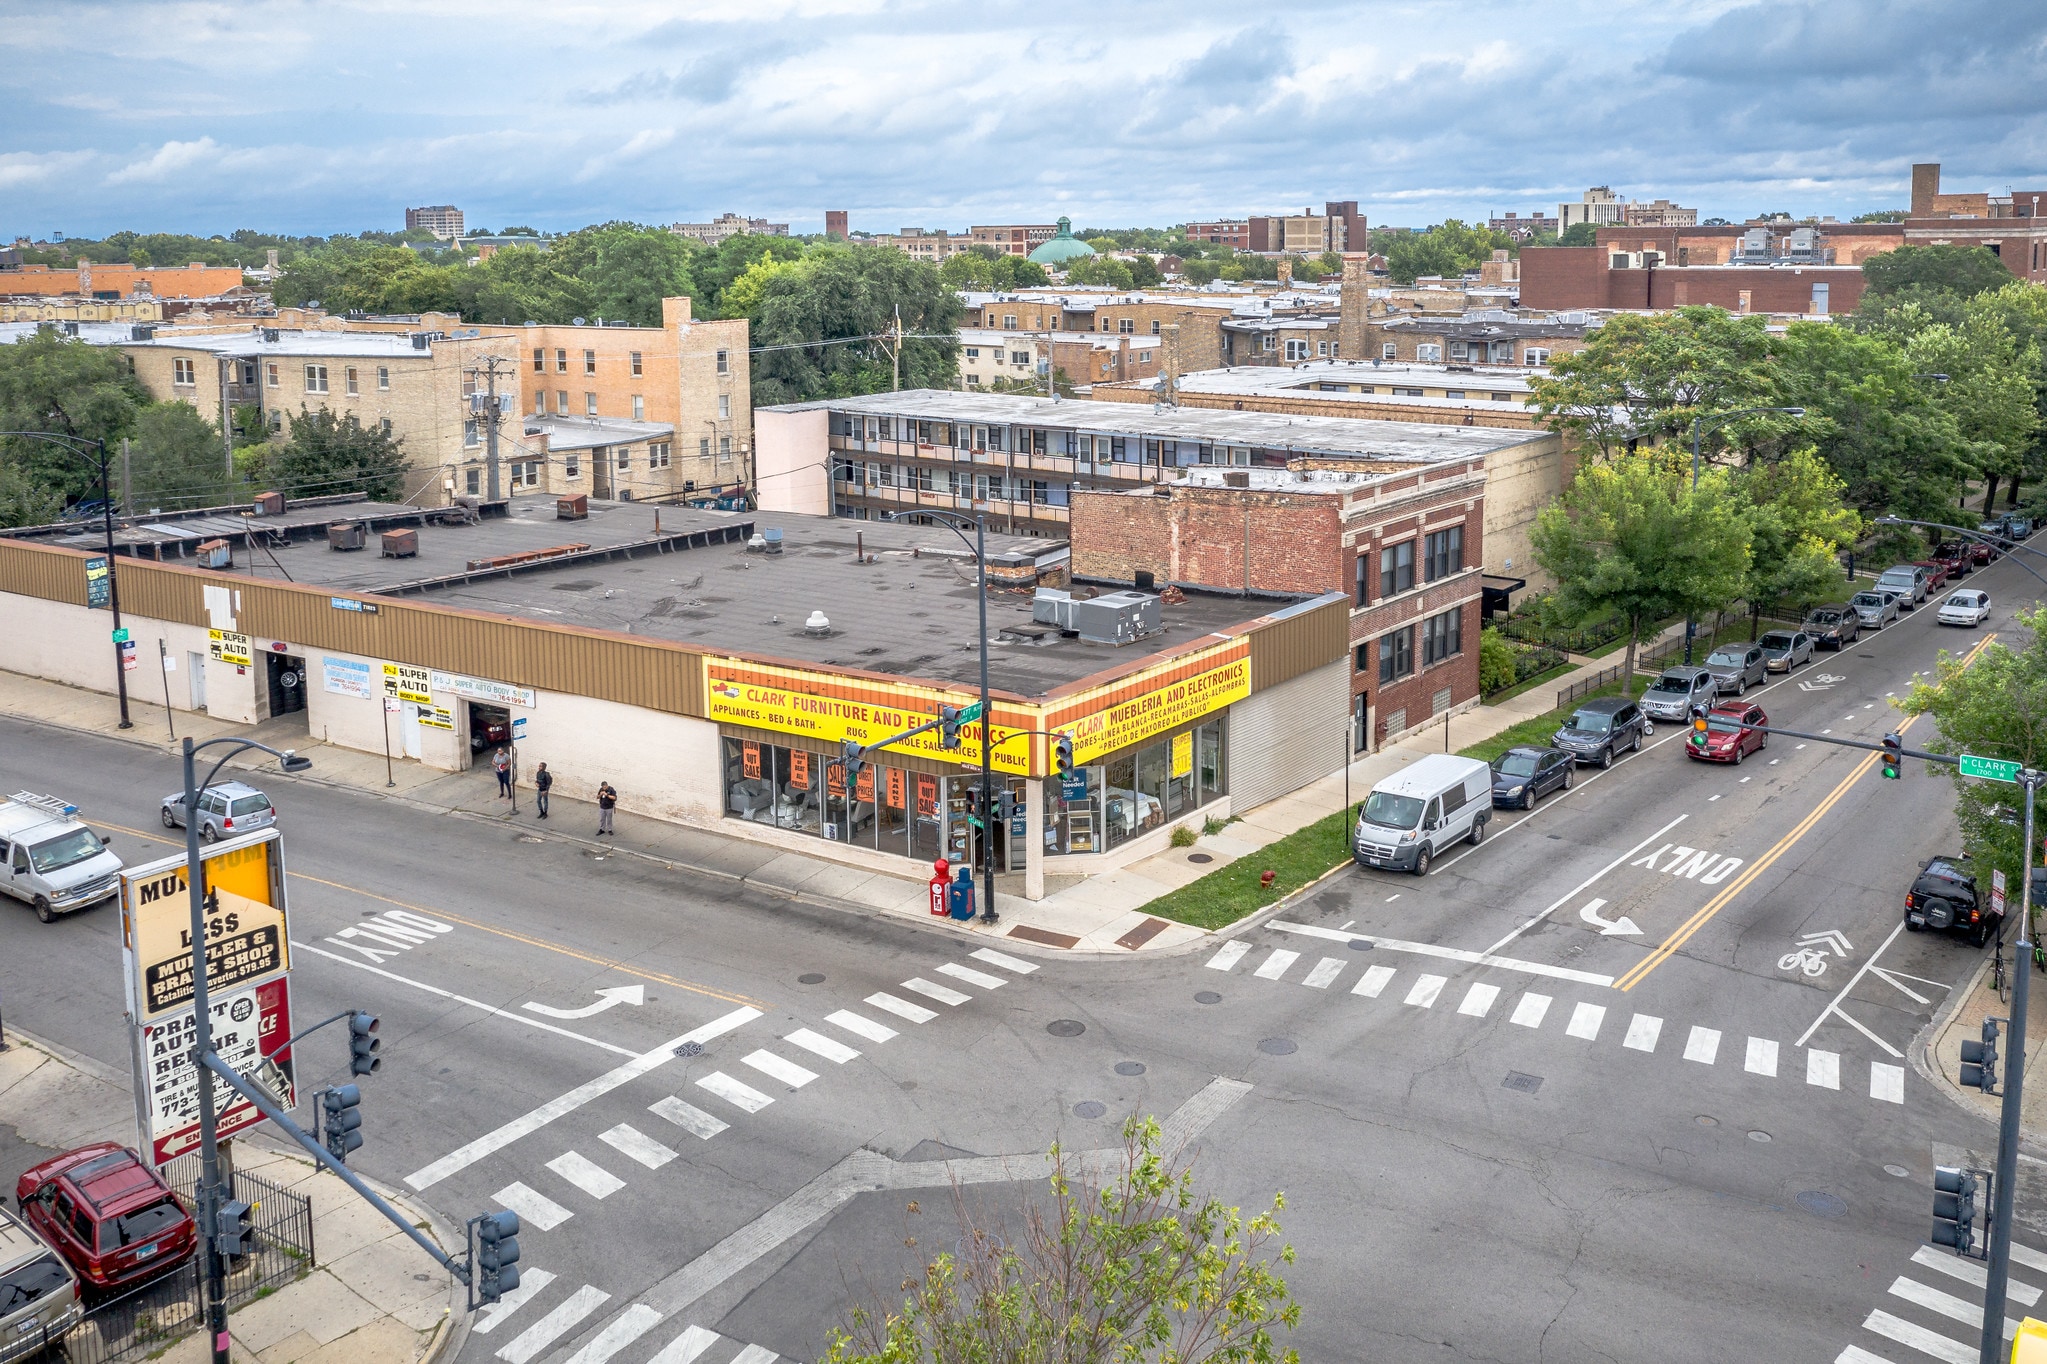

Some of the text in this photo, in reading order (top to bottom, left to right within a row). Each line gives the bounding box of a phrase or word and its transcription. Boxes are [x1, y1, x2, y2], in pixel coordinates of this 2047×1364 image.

[223, 632, 246, 644] SUPER
[224, 644, 247, 655] AUTO
[400, 668, 428, 681] SUPER
[400, 680, 428, 692] AUTO
[455, 680, 472, 689] SUPER
[476, 683, 492, 692] AUTO
[494, 686, 510, 696] BODY
[1076, 664, 1243, 739] CLARK MUEBLERIA AND ELECTRONICS
[747, 688, 1006, 744] CLARK FURNITURE AND ELEONCS
[714, 704, 760, 720] APPLIANCES
[768, 714, 784, 724] BED
[787, 717, 792, 726] &
[795, 718, 815, 730] BATH
[846, 726, 868, 739] RUGS
[924, 740, 944, 752] SALE
[994, 752, 1026, 766] PUBLIC
[1130, 732, 1138, 742] DE
[1140, 718, 1170, 740] MAYOREO
[1172, 714, 1180, 724] AL
[746, 754, 756, 764] OUT
[1972, 759, 2006, 771] CLARK
[744, 765, 760, 779] SALE
[858, 786, 873, 796] PRICES
[922, 787, 933, 799] OUT
[919, 800, 936, 814] SALE
[1630, 843, 1744, 884] ONLY
[202, 885, 220, 915] 4
[1931, 908, 1947, 917] Jeep
[323, 910, 454, 964] ONLY
[158, 932, 266, 979] MULER &
[152, 943, 274, 996] BRAE SHOP
[157, 987, 194, 1005] Catalitic
[239, 958, 271, 976] $79.95
[234, 1000, 249, 1011] OPEN
[152, 1002, 228, 1042] PRAT
[260, 1013, 277, 1032] CE
[155, 1032, 239, 1076] REIR
[160, 1093, 178, 1105] TIRE
[180, 1088, 184, 1097] &
[233, 1060, 254, 1073] RVICE
[186, 1113, 242, 1144] ENANCE
